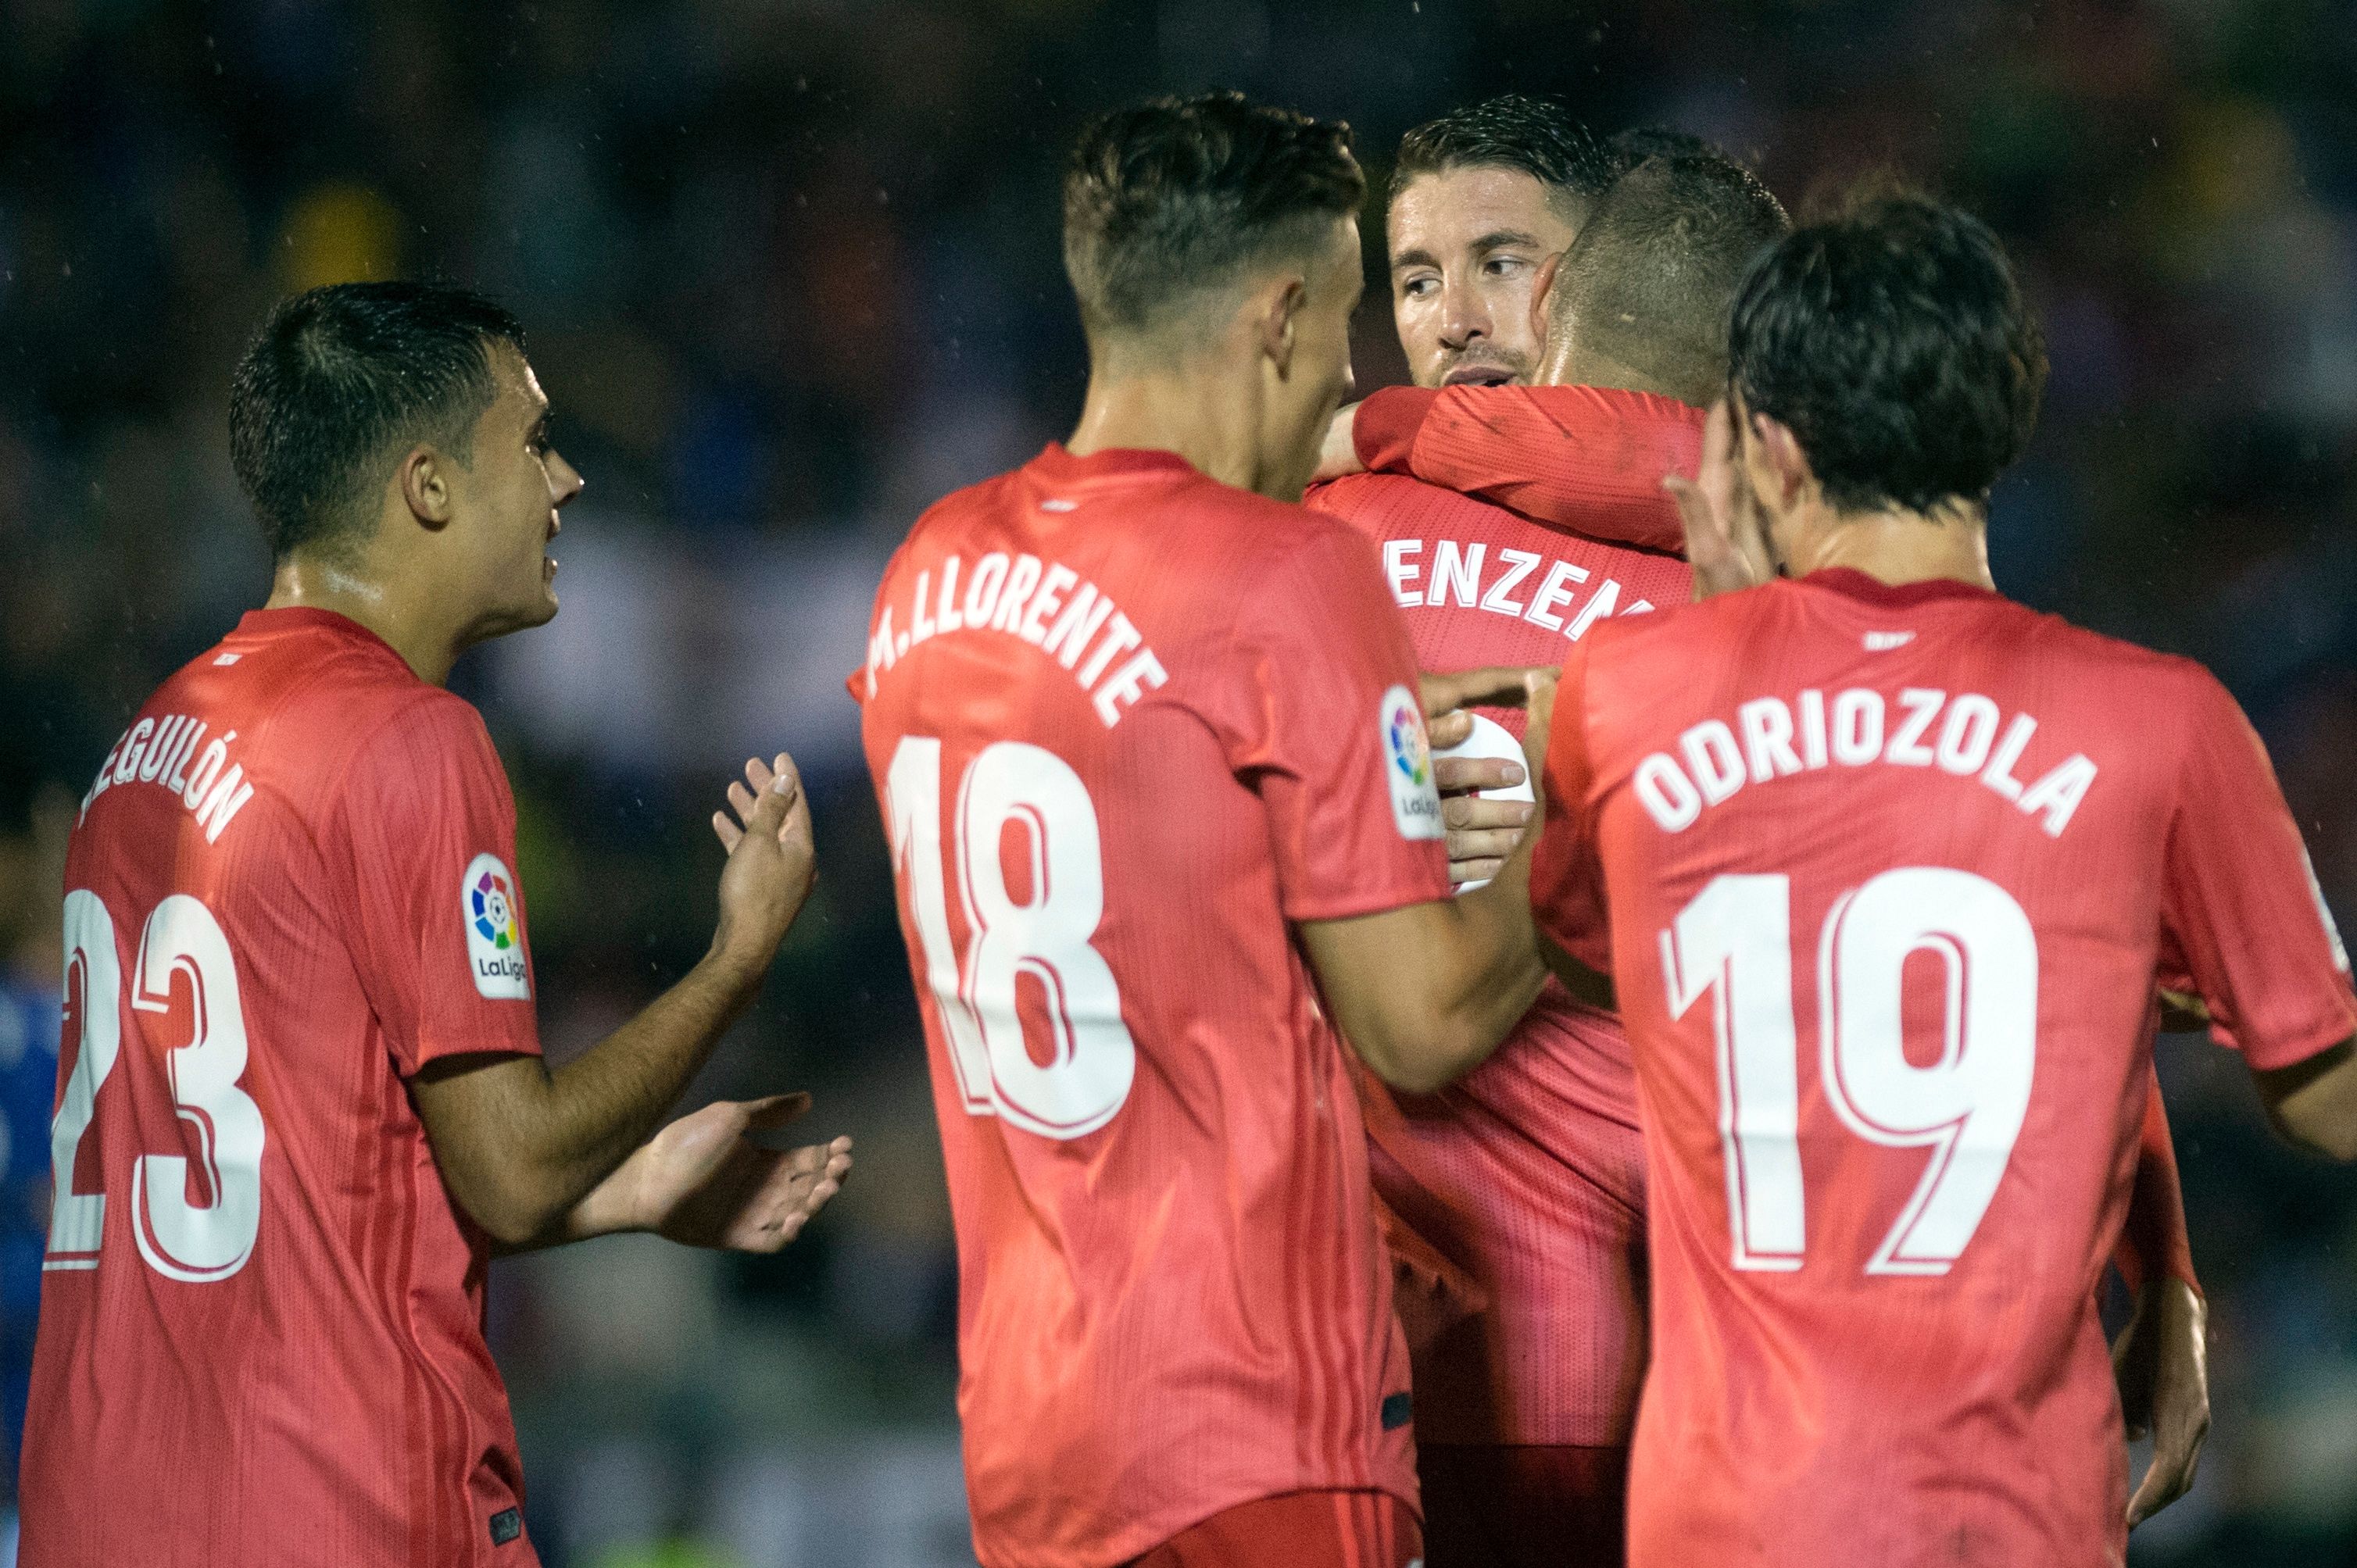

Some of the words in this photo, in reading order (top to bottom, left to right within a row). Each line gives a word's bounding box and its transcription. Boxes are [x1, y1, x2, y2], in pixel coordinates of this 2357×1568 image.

[1382, 538, 1655, 642] ENZEM
[1633, 687, 2099, 838] ODRIOZOLA
[41, 888, 266, 1284] 23
[885, 734, 1136, 1141] 18
[1658, 865, 2040, 1277] 19
